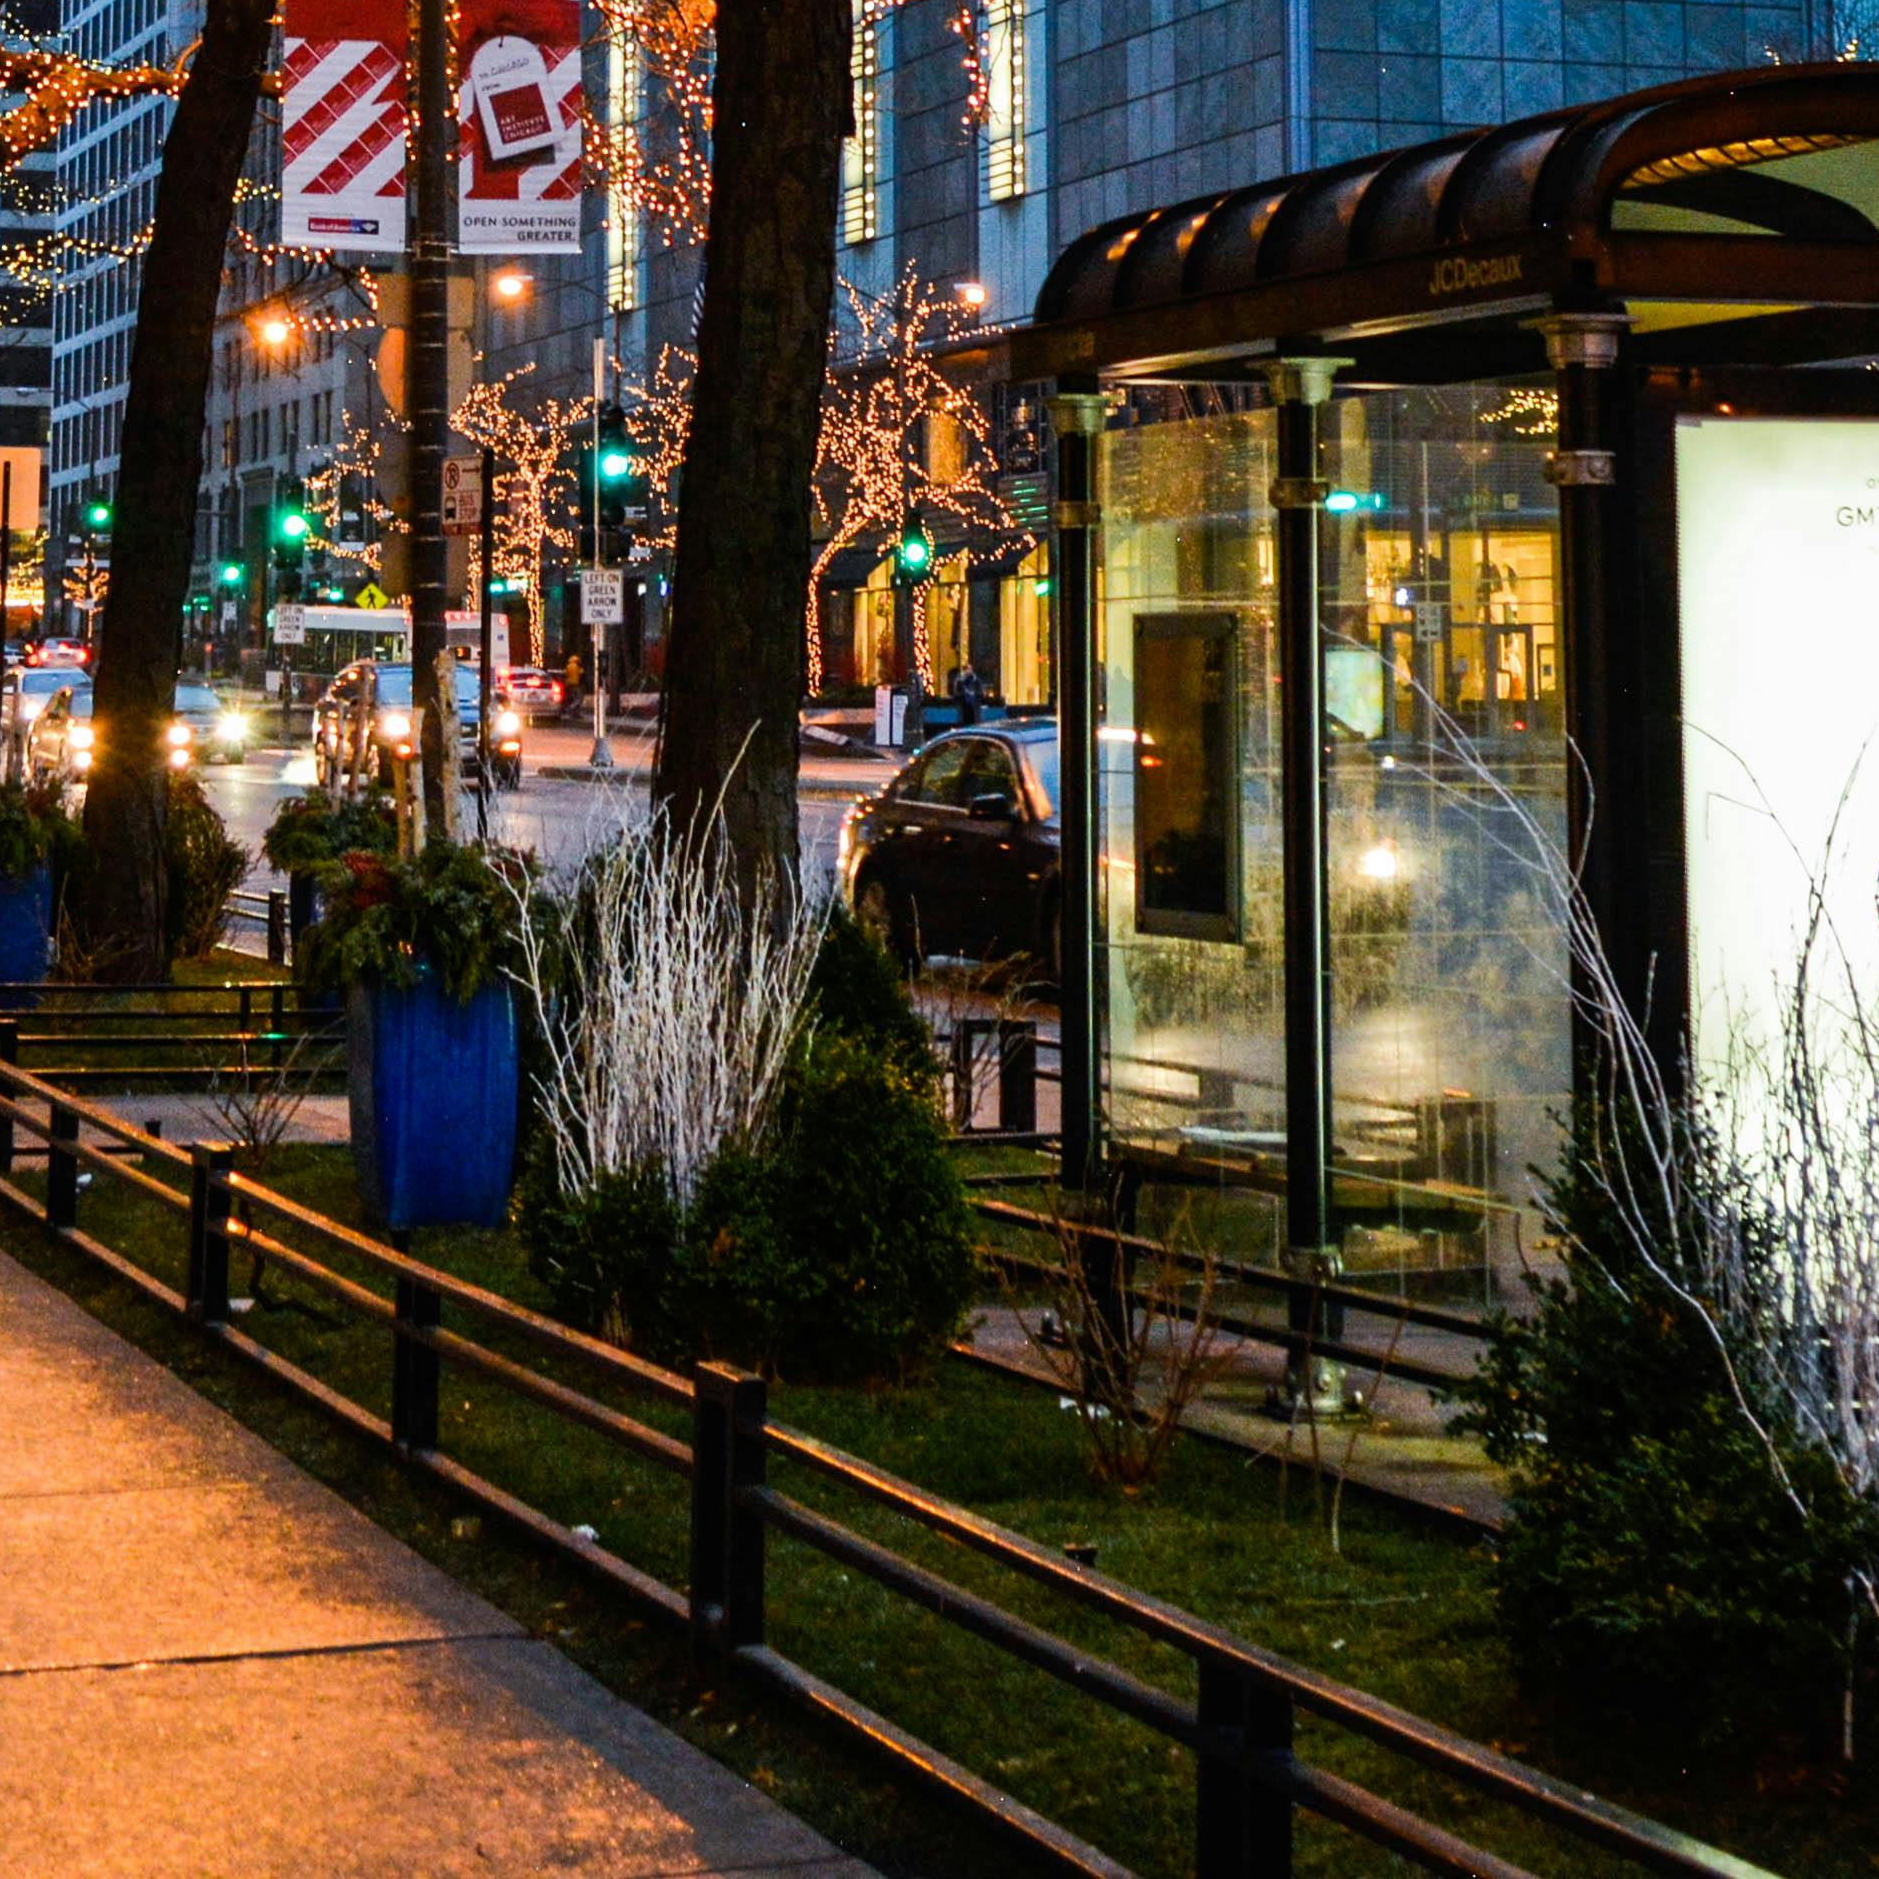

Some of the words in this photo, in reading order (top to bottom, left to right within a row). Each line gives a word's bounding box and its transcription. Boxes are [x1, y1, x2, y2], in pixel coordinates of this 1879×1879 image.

[501, 115, 516, 125] ART
[463, 217, 497, 227] OPEN
[502, 217, 577, 227] SOMETHING
[517, 231, 577, 242] GREATER.
[1429, 254, 1523, 296] JCDecaux
[585, 573, 604, 583] LEFT
[608, 573, 619, 583] ON
[588, 585, 616, 595] GREEN
[588, 597, 616, 606] ARROW
[591, 609, 612, 618] ONLY
